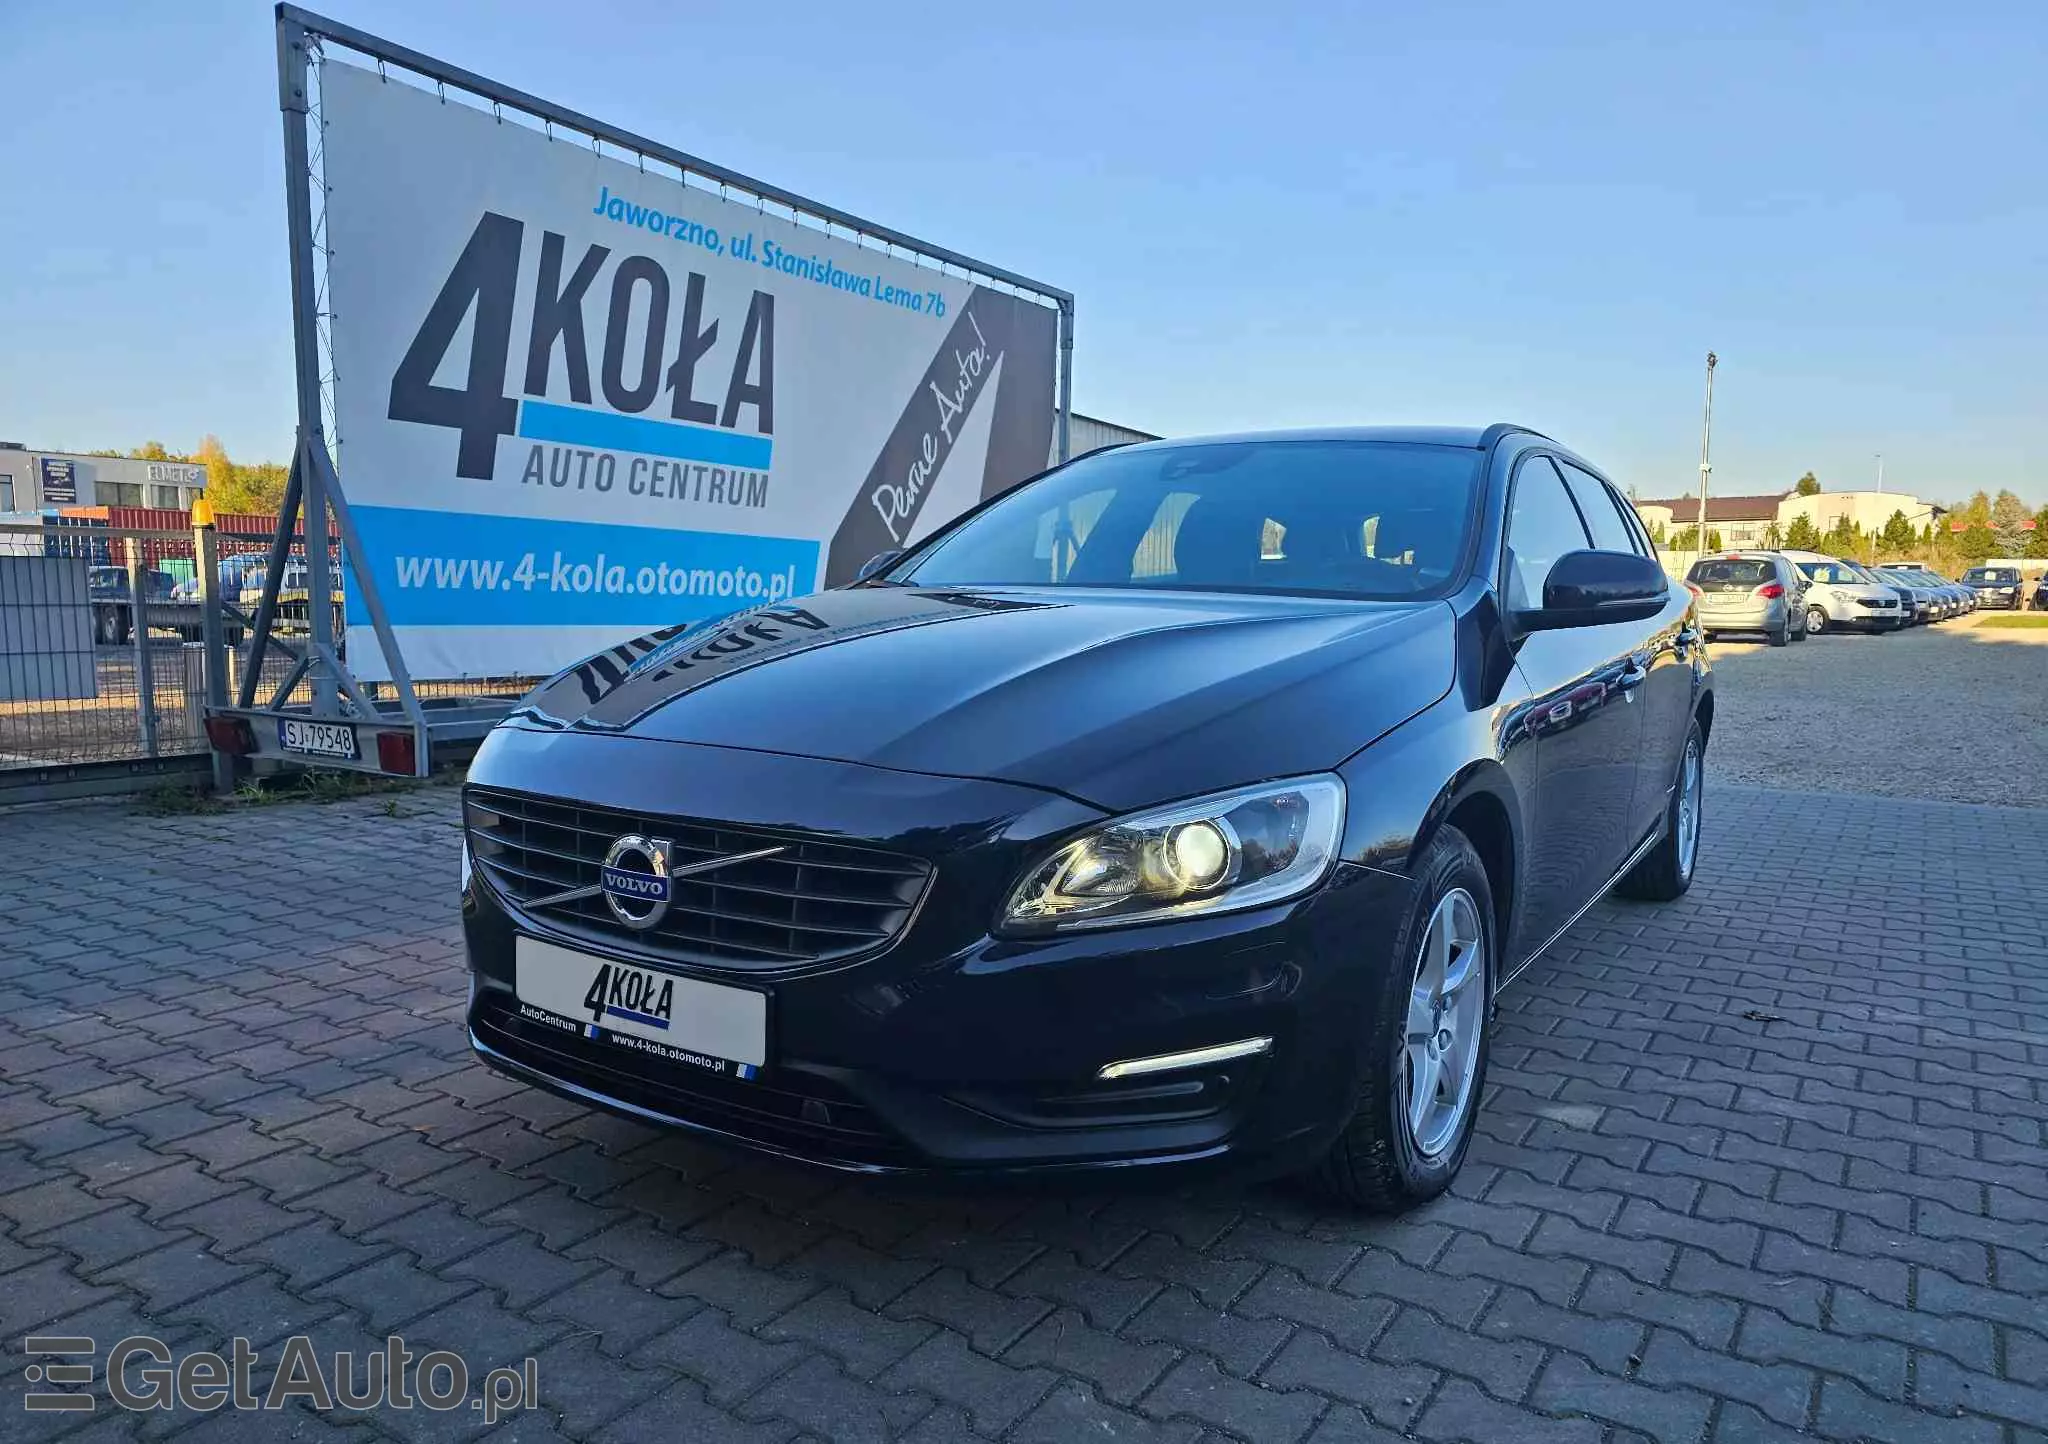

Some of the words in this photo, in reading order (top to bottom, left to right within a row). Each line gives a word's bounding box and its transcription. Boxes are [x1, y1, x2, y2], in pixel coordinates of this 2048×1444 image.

[593, 186, 725, 257] Jaworzno,
[730, 233, 757, 263] ul.
[762, 240, 871, 297] Stanisława
[874, 276, 922, 311] Lema
[926, 291, 946, 318] 7b
[930, 312, 991, 444] Auta!
[521, 444, 616, 492] AUTO
[628, 457, 769, 508] CENTRUM
[395, 551, 796, 602] www.4-kola.otomoto.pl
[604, 872, 663, 895] VOLVO
[520, 1004, 577, 1033] AutoCentrum
[612, 1034, 726, 1072] www.4-kola.otomoto.pl
